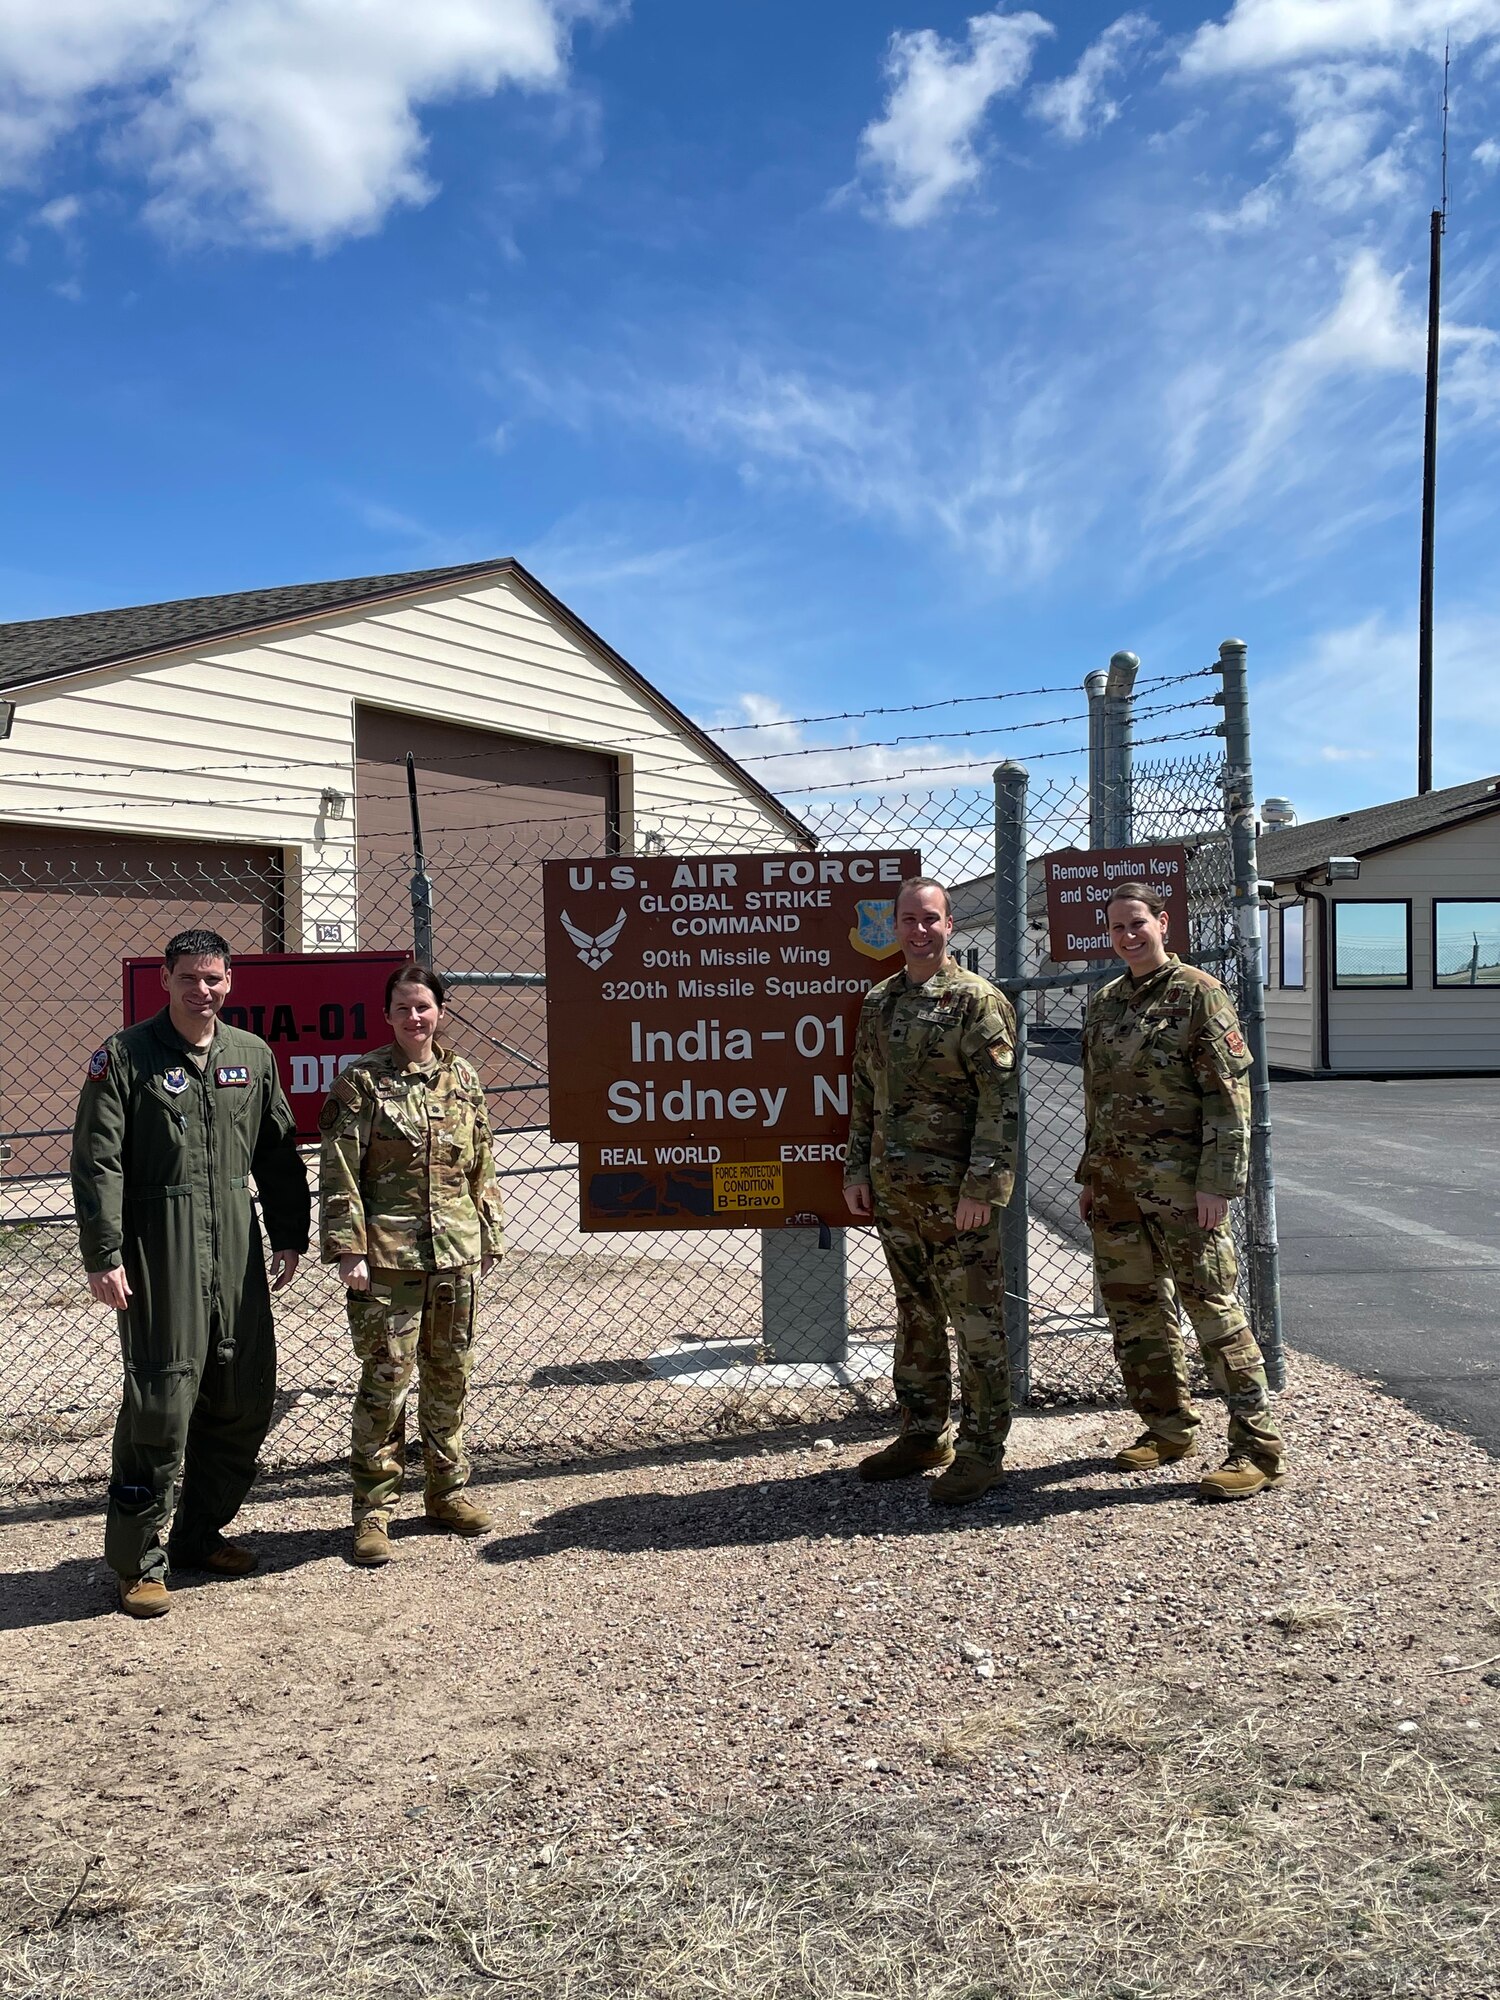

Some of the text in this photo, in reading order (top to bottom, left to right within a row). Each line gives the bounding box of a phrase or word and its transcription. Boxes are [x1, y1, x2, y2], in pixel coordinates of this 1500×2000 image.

[569, 858, 903, 891] U.S. AIR FORCE
[1052, 858, 1179, 880] Remove Ignition Keys
[639, 890, 832, 913] GLOBAL STRIKE
[1060, 886, 1082, 904] and
[319, 926, 339, 940] 125
[671, 914, 801, 936] COMMAND
[1067, 932, 1112, 952] Departi
[642, 946, 831, 968] 90th Missile Wing
[601, 975, 873, 1000] 320th Missile Squadron
[219, 1003, 368, 1042] DIA-01
[630, 1014, 845, 1063] India-01
[607, 1073, 854, 1127] Sidney N
[600, 1143, 847, 1166] REAL WORLD EXERC
[715, 1164, 781, 1179] FORCE PROTECTION
[723, 1179, 775, 1193] CONDITION
[717, 1194, 781, 1208] B-Bravo
